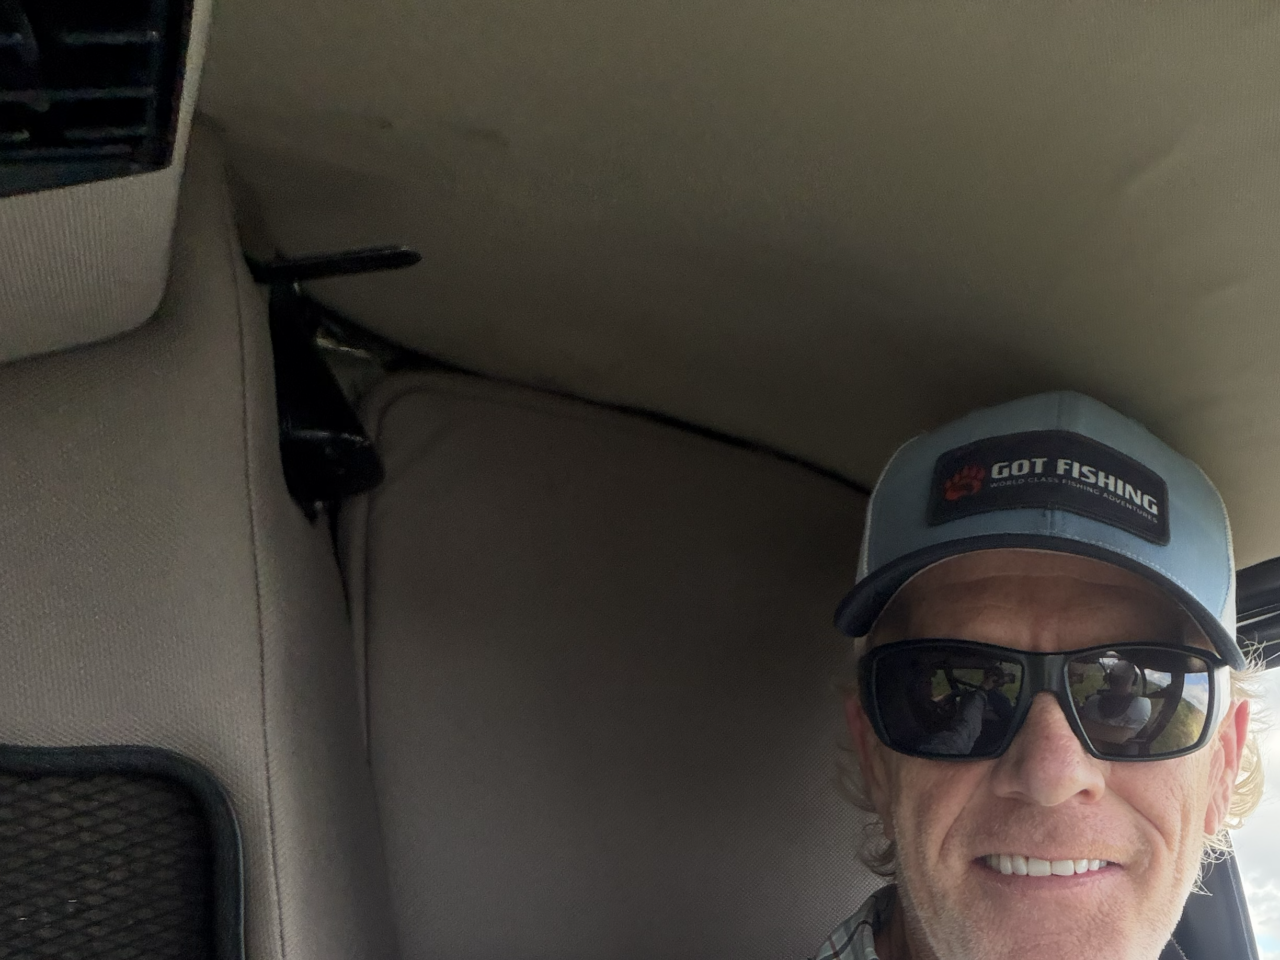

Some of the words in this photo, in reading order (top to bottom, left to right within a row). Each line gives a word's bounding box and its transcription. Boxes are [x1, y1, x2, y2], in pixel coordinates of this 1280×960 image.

[990, 478, 1024, 488] WORLD
[1027, 476, 1059, 484] CLASS
[1062, 479, 1100, 495] FISHING
[1102, 493, 1158, 524] ADVENTURES
[991, 457, 1048, 479] GOT
[1056, 458, 1158, 515] FISHING
